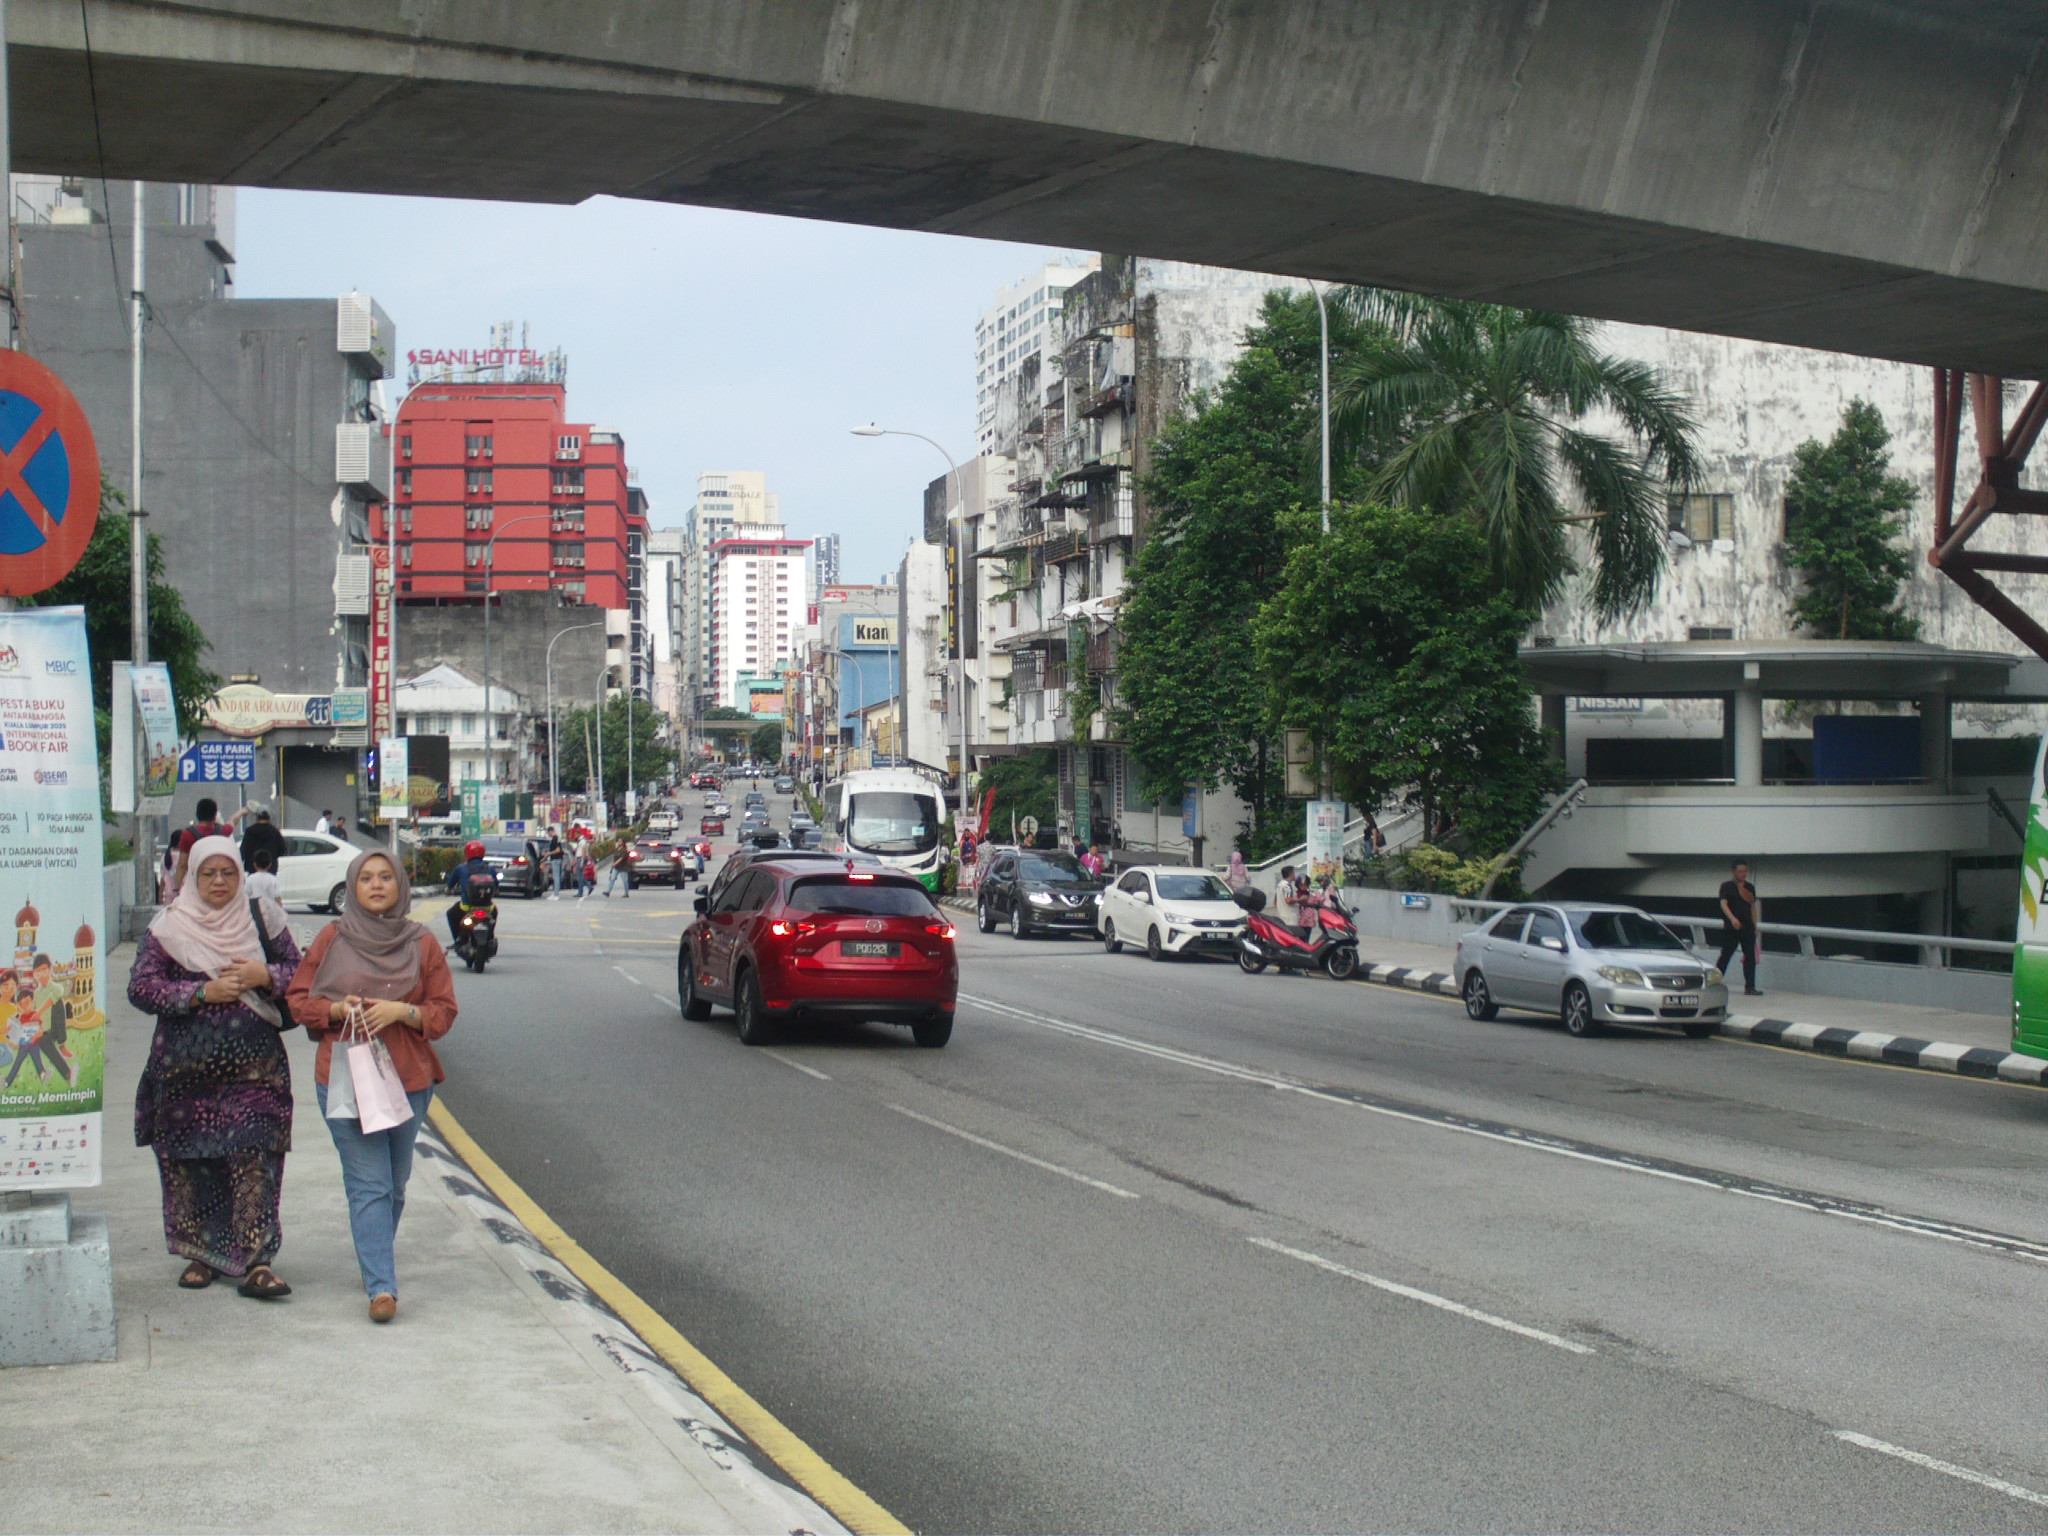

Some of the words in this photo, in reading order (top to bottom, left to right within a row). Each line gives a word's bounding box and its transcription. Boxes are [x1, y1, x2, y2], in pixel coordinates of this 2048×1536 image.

[419, 349, 468, 365] SANI
[473, 349, 544, 366] HOTEL
[375, 567, 390, 637] HOTEL
[856, 624, 889, 640] Kian
[45, 659, 77, 673] MBIC
[0, 698, 31, 710] PESTA
[33, 699, 65, 711] BUKU
[1579, 698, 1640, 709] NISSAN
[6, 730, 69, 740] INTERNATIONAL
[8, 740, 39, 753] BOOK
[41, 741, 69, 753] FAIR
[201, 744, 223, 754] CAR
[225, 744, 253, 754] PARK
[183, 759, 196, 781] P
[37, 812, 45, 822] 10
[49, 825, 57, 834] 10
[57, 825, 85, 834] MALAM
[8, 847, 55, 856] DAGANGAN
[55, 846, 79, 856] DUNIA
[11, 859, 43, 869] LUMPUR
[1, 1094, 36, 1105] baca,
[38, 1088, 96, 1103] Memimpin
